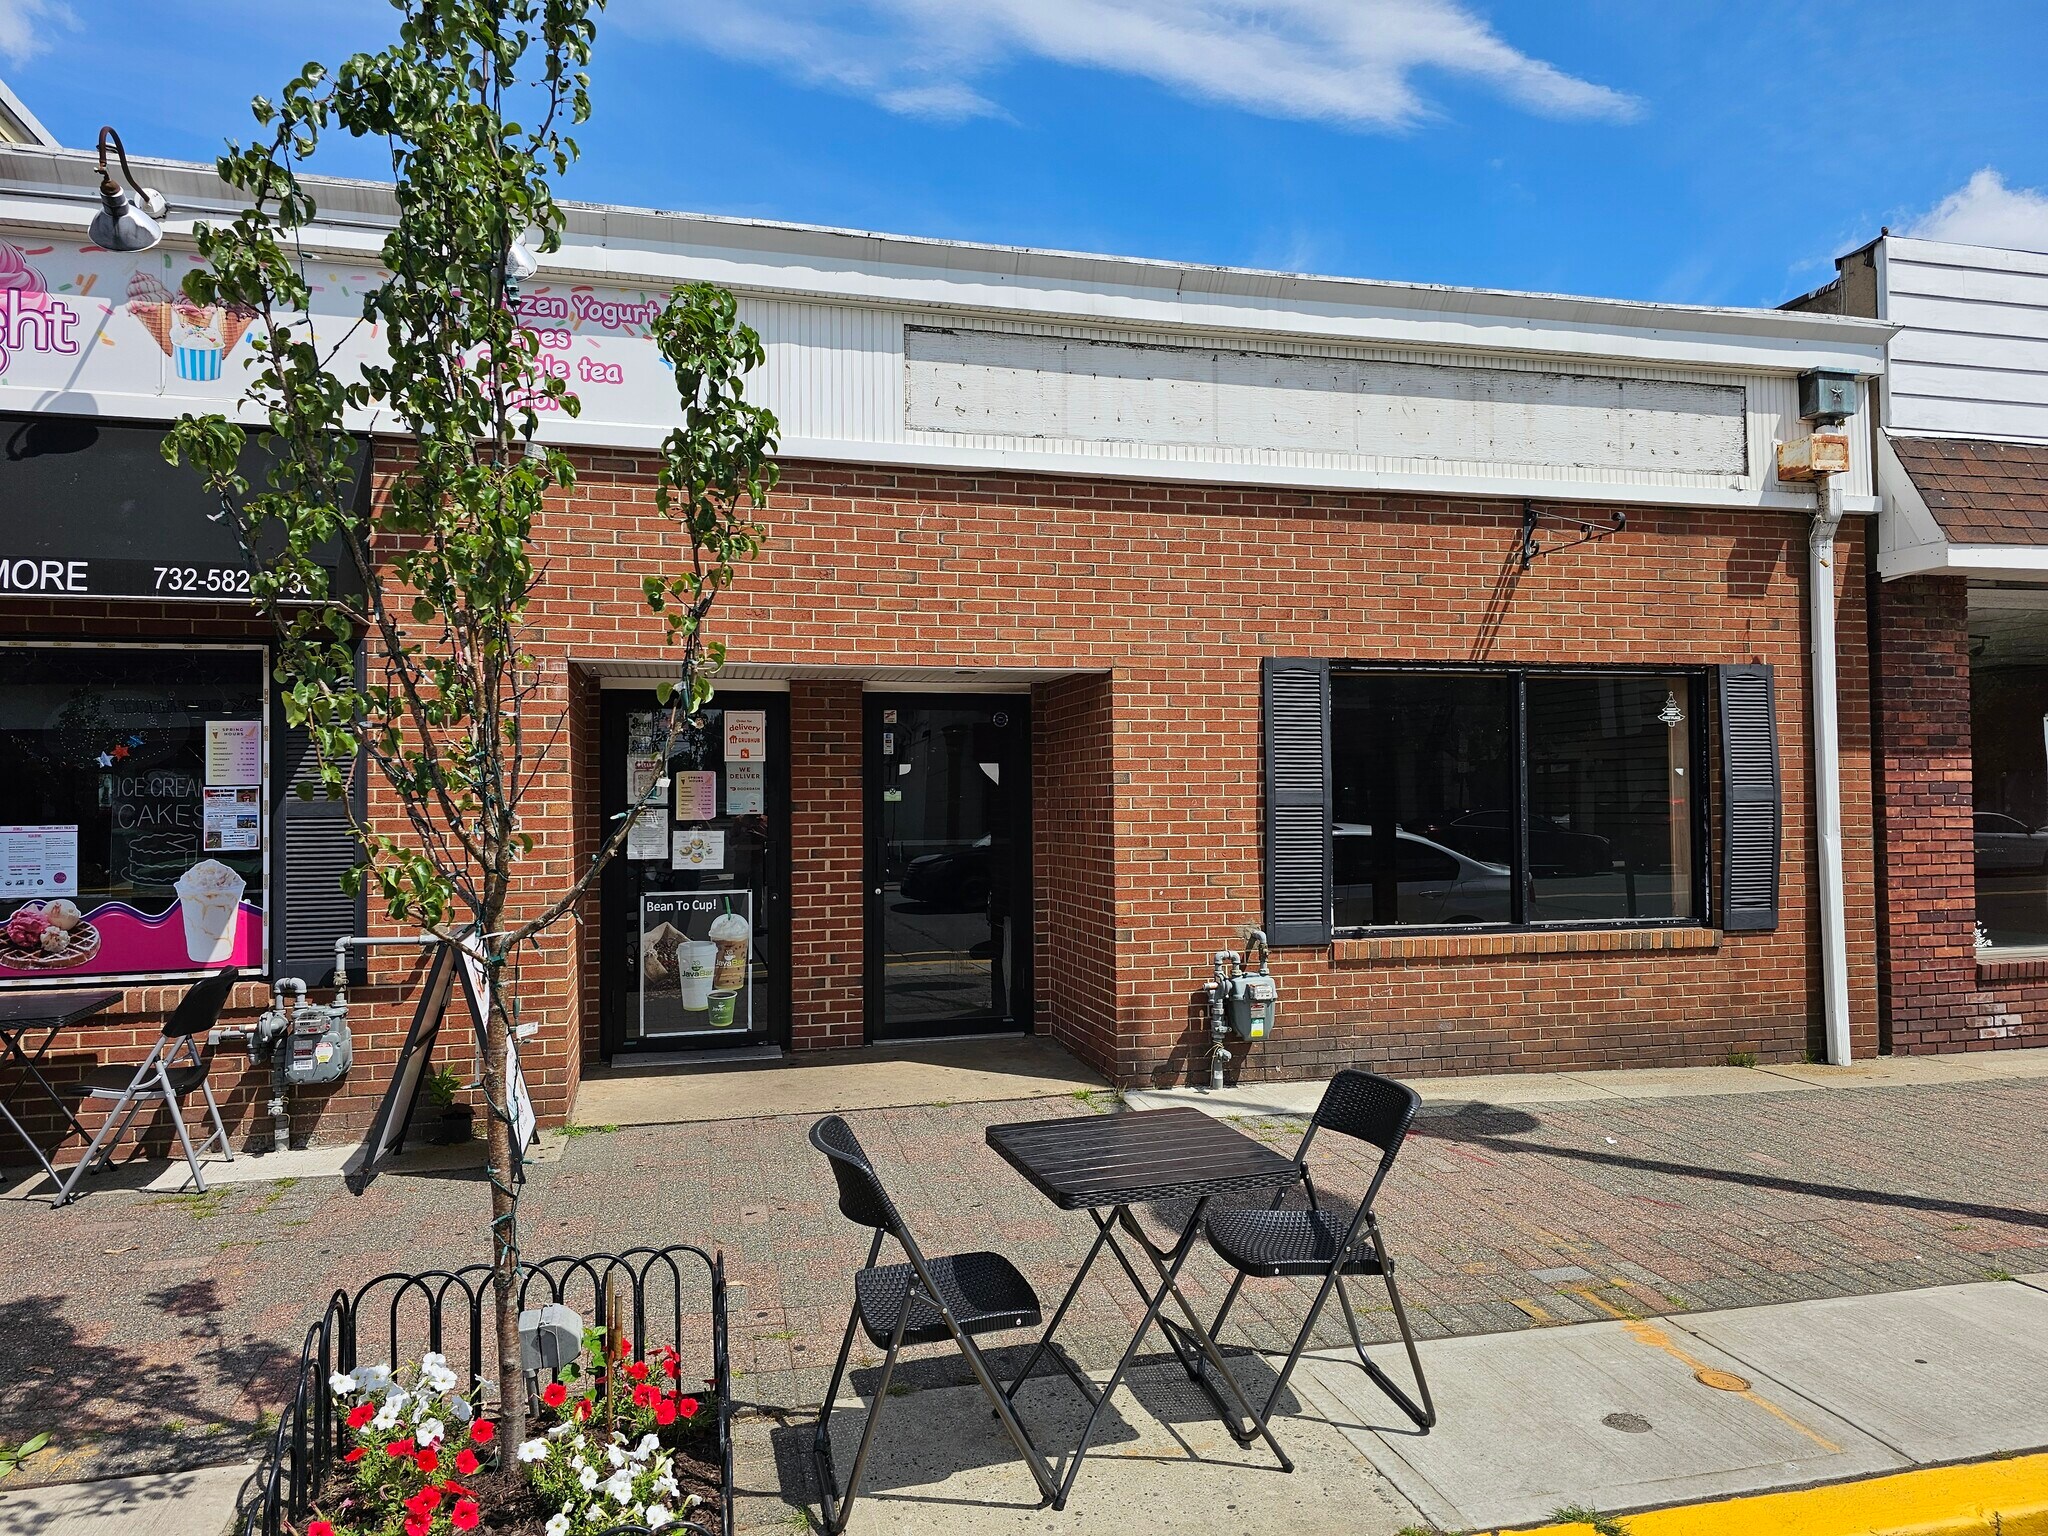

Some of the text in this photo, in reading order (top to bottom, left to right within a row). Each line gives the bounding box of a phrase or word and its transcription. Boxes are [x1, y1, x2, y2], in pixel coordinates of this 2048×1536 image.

[571, 294, 662, 329] Yogurt
[578, 356, 624, 385] tea
[510, 388, 579, 411] mor
[729, 723, 761, 733] delivery
[117, 777, 145, 798] ICE
[646, 898, 717, 913] Bean To Cup!
[681, 969, 713, 978] JavaBar
